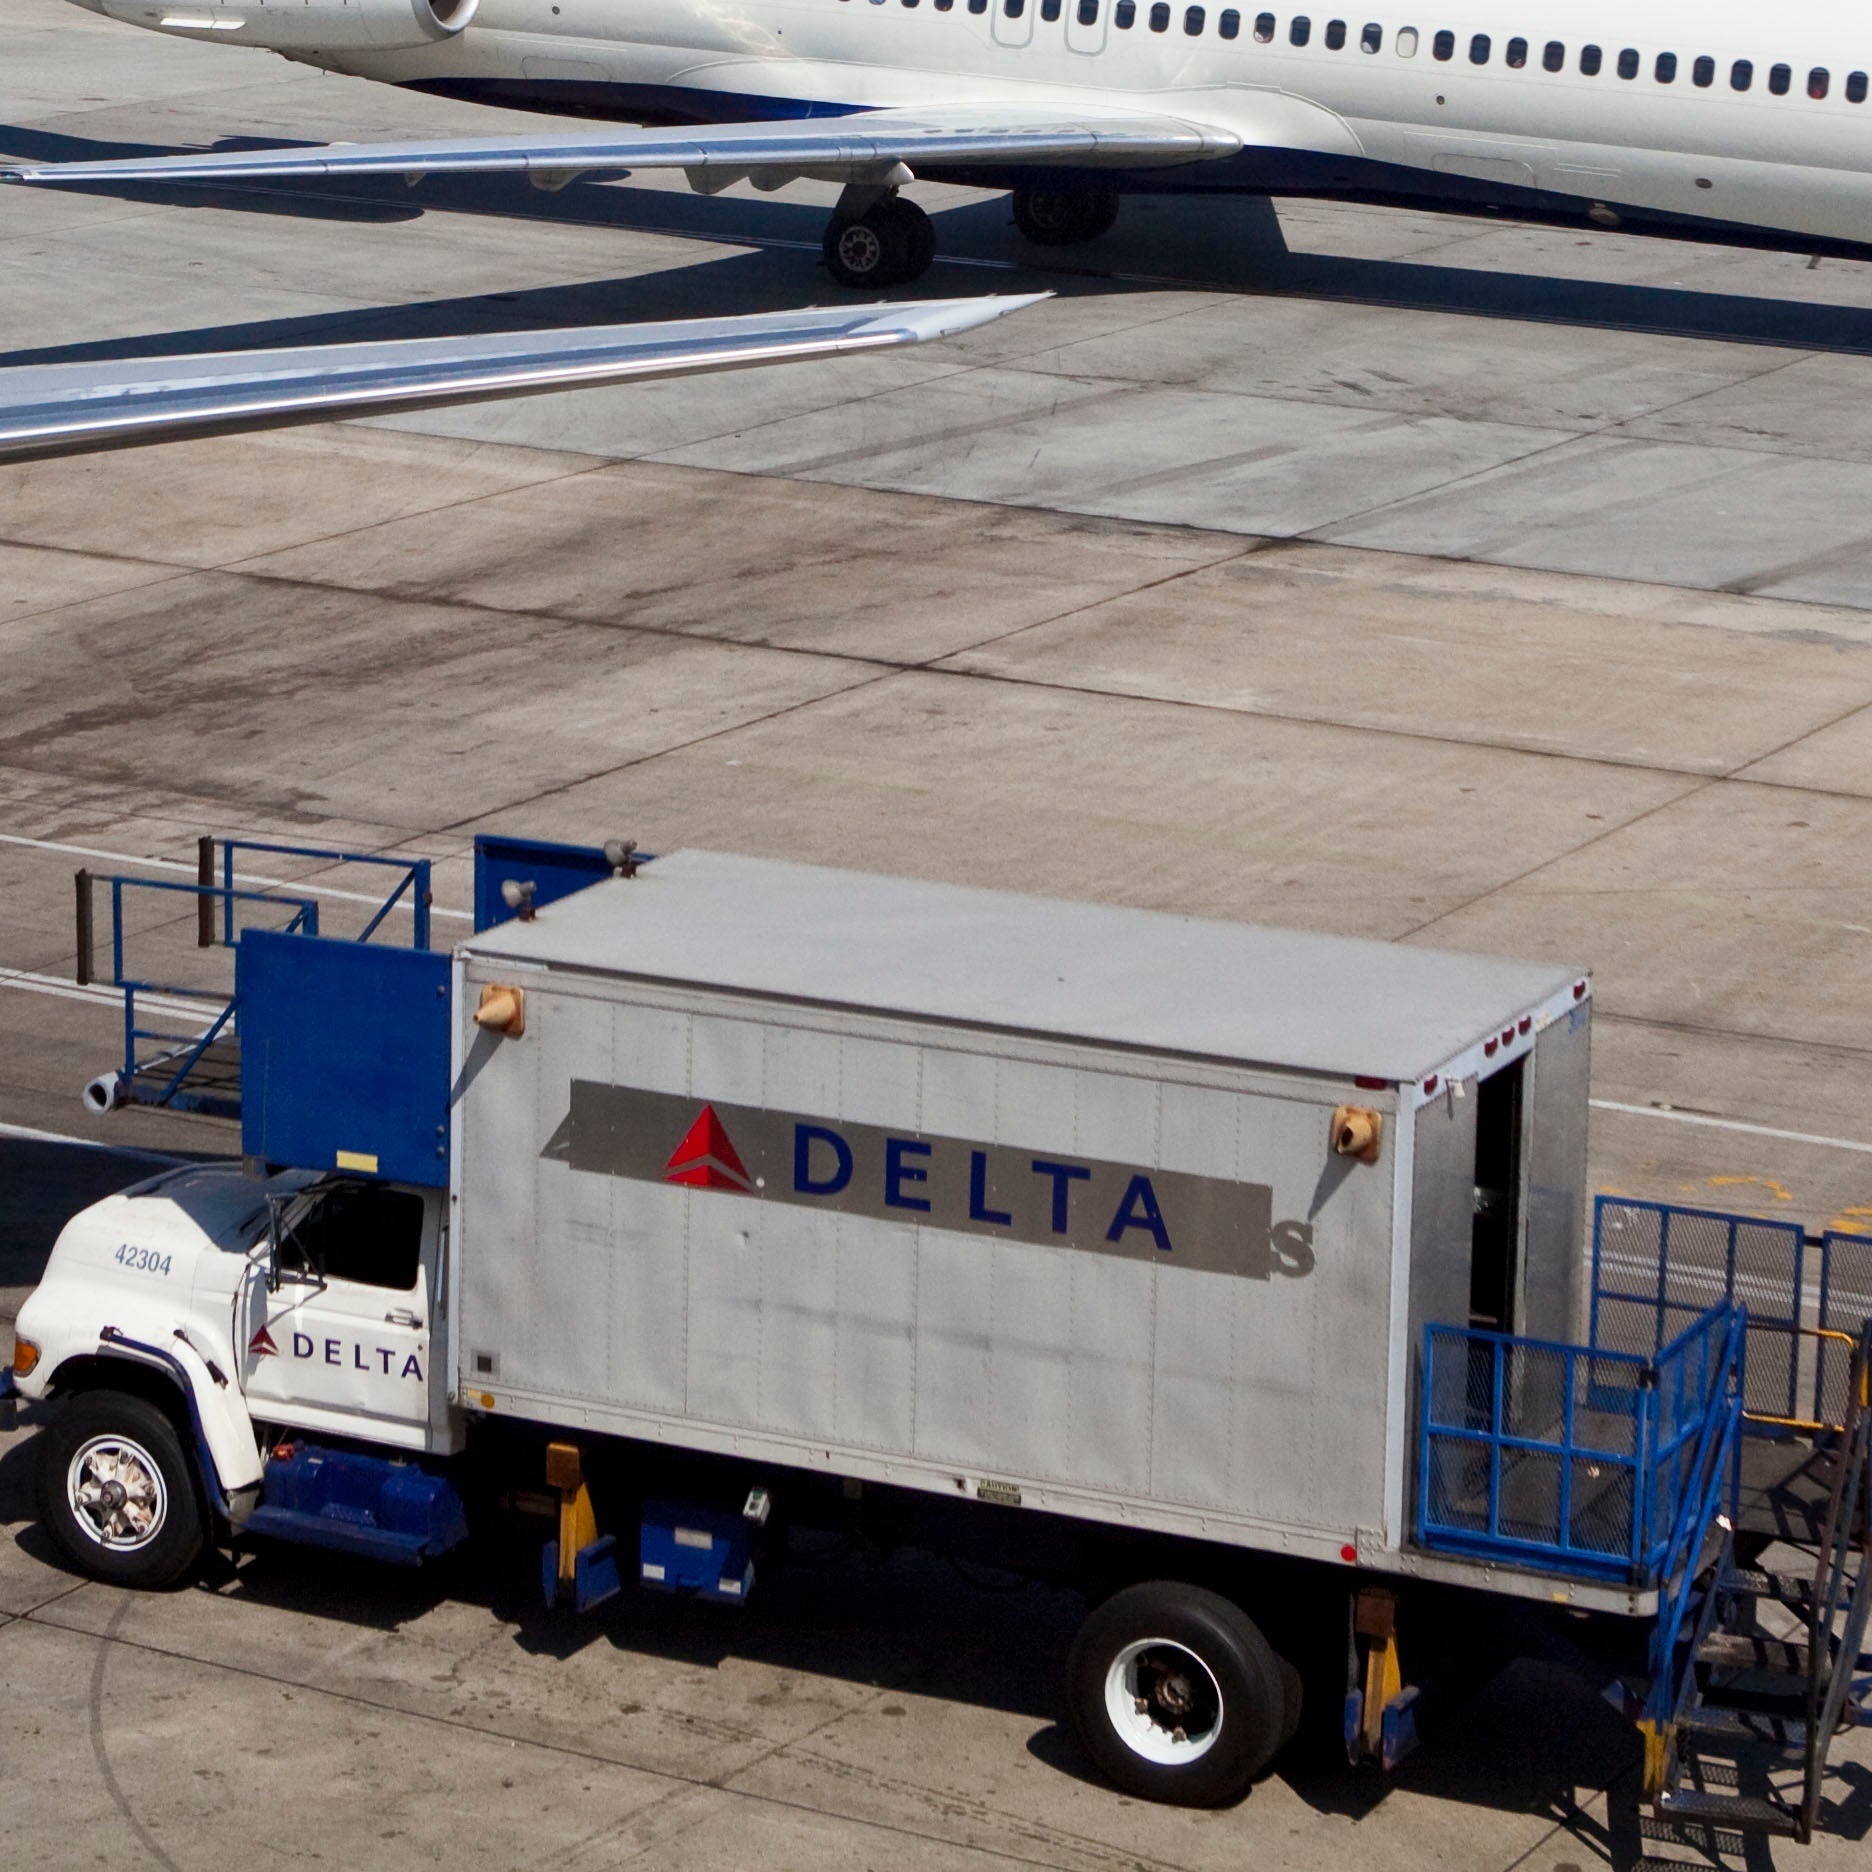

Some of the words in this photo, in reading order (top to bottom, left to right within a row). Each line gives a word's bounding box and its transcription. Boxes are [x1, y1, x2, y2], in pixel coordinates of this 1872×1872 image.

[793, 1123, 1174, 1252] DELTA
[115, 1244, 173, 1277] 42304
[293, 1332, 424, 1382] DELTA
